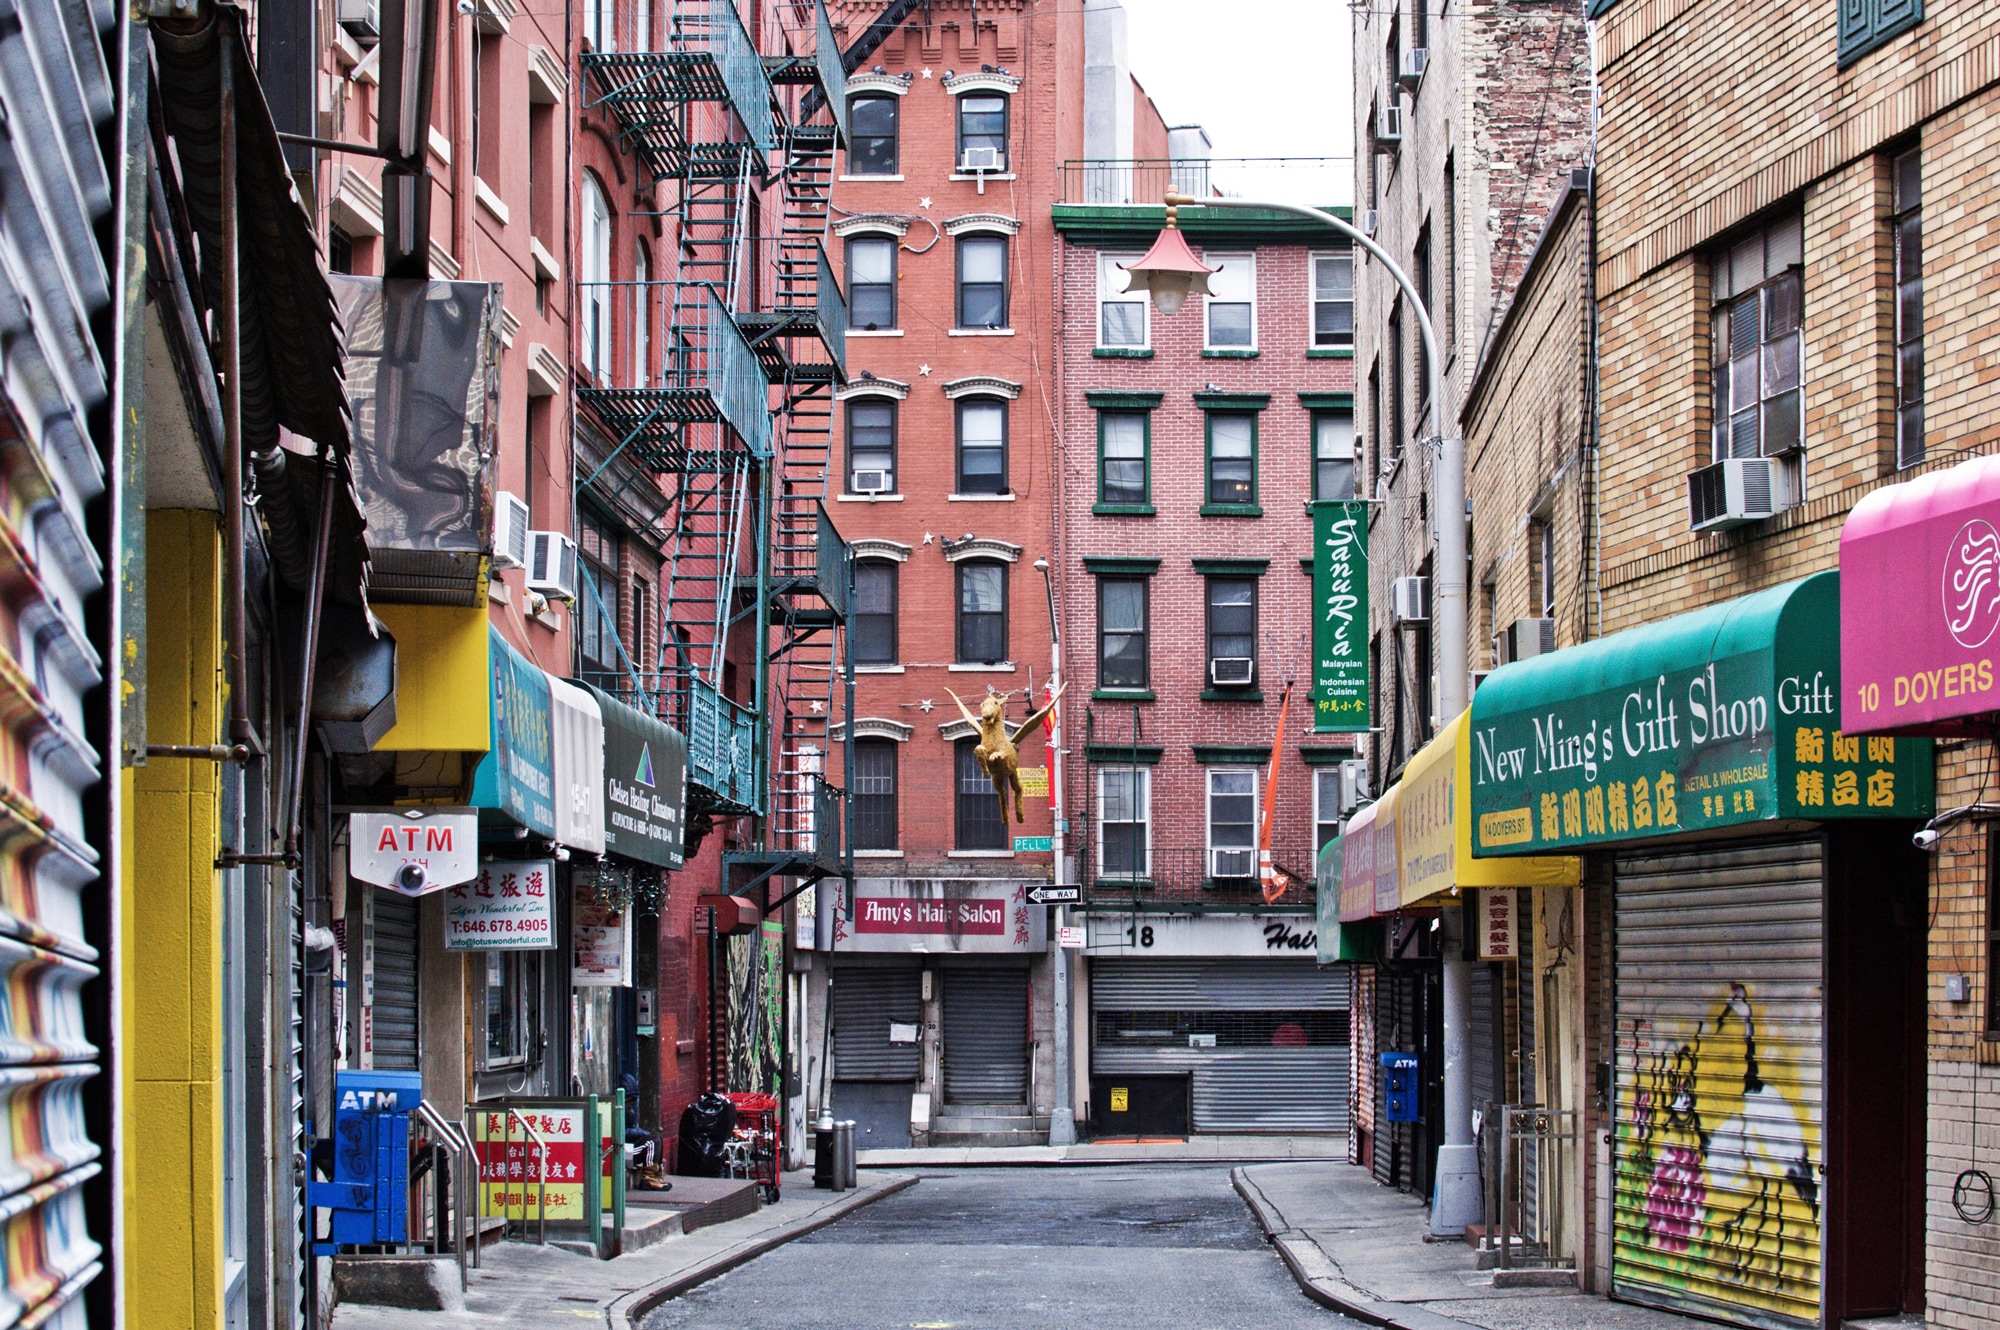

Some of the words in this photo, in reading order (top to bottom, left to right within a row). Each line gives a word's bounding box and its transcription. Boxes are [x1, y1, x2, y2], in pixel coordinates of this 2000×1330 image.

[1322, 660, 1363, 669] Malaysian
[1320, 678, 1365, 686] Indonesian
[1858, 683, 1879, 713] 10
[1894, 659, 1993, 707] DOYERS
[1327, 688, 1358, 696] Cuisine
[1778, 671, 1834, 714] Gift
[1476, 727, 1526, 785] New
[1532, 713, 1613, 782] Ming's
[1621, 675, 1680, 757] Gift
[1689, 662, 1767, 753] Shop
[1684, 775, 1711, 792] RETAIL
[1713, 773, 1719, 787] &
[1720, 763, 1768, 785] WHOLESALE
[1795, 769, 1895, 807] 精品店
[572, 783, 590, 815] 15-17
[609, 778, 629, 806] Chelsea
[630, 786, 650, 821] Healing
[651, 794, 676, 823] Chinatown
[1485, 824, 1491, 837] 14
[1492, 819, 1516, 836] DOYERS
[377, 827, 453, 852] ATM
[1015, 839, 1041, 850] PELL
[1034, 891, 1049, 899] ONE
[480, 903, 526, 914] Wonderful
[528, 901, 547, 912] Inc.
[864, 901, 912, 925] Amy's
[917, 903, 951, 923] Hair
[958, 903, 1001, 924] Salon
[451, 919, 548, 933] T:646.678.4905
[451, 937, 548, 947] info@lotuswonderful.com
[1394, 1060, 1418, 1068] ATM
[340, 1090, 397, 1110] ATM
